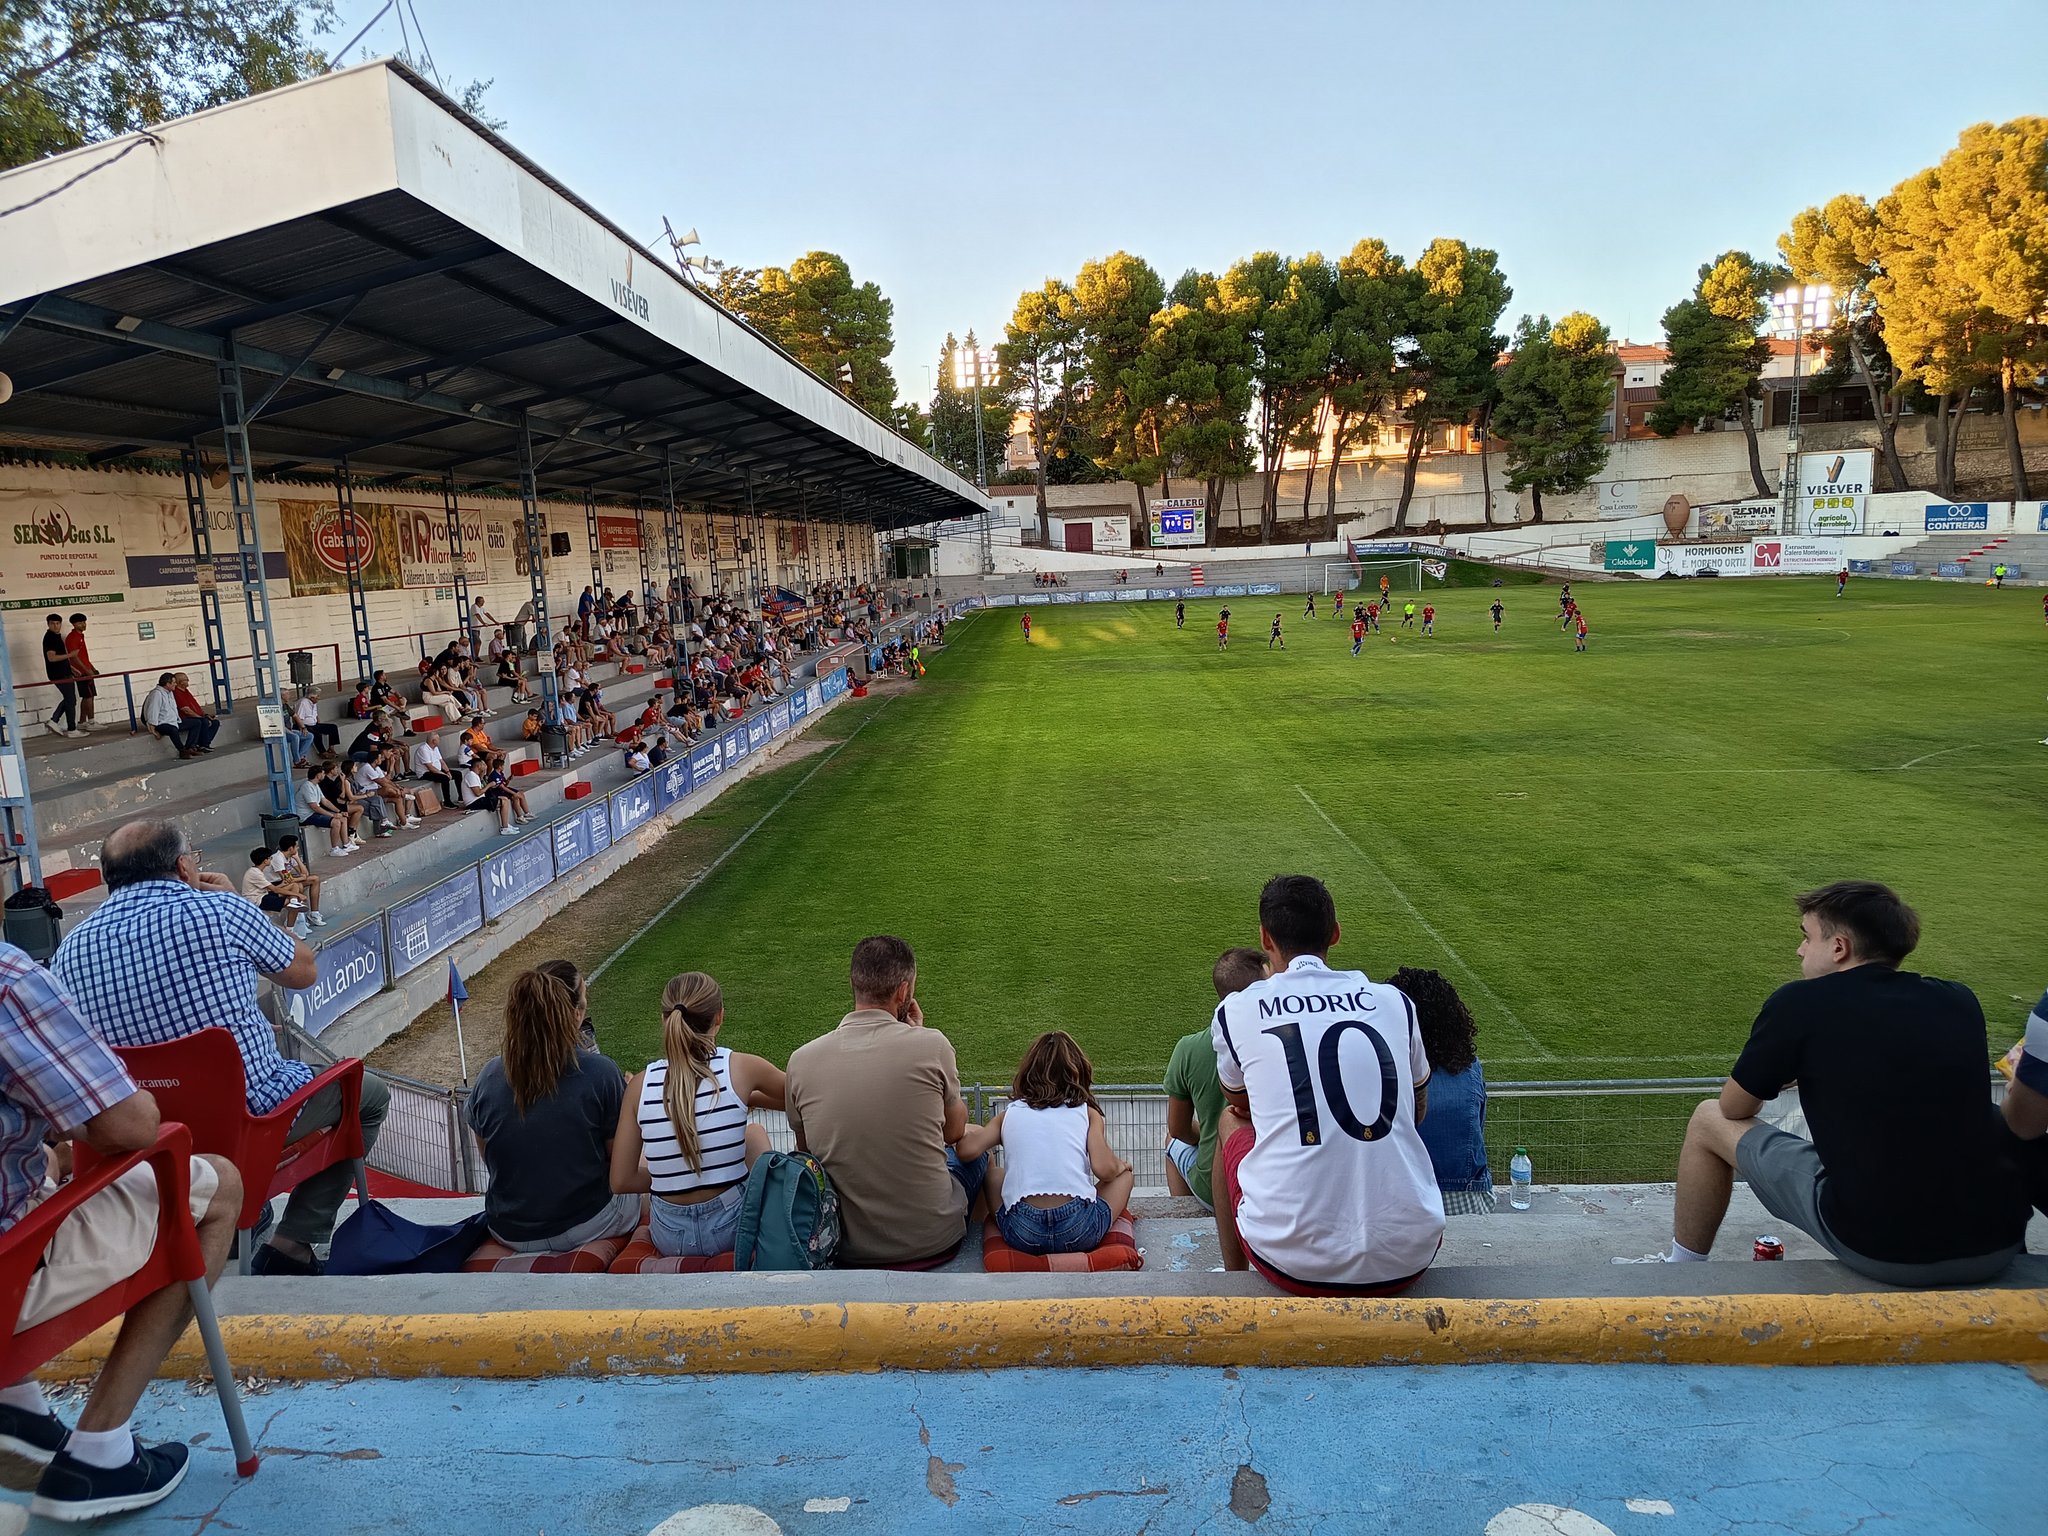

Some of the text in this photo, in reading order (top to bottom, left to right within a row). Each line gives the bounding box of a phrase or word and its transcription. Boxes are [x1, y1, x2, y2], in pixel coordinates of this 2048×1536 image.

[611, 278, 649, 322] VISEVER
[1807, 484, 1863, 495] VISEVER
[1167, 499, 1204, 507] CALERO
[1731, 507, 1776, 515] RESMAN
[1818, 514, 1847, 522] agrícola
[487, 522, 504, 533] BALÓN
[1927, 521, 1985, 530] CONTRERAS
[94, 525, 115, 543] S.L.
[488, 534, 505, 548] ORO
[1685, 546, 1745, 557] HORMIGONES
[1611, 558, 1648, 567] Globalcaja
[1691, 559, 1722, 569] MORENO
[1725, 558, 1746, 567] ORTIZ
[26, 571, 78, 579] TRANSFORMACIÓN
[87, 569, 115, 577] VEHÍCULOS
[75, 581, 90, 590] GLP
[67, 595, 110, 605] VILLARROBLEDO
[1259, 987, 1376, 1020] MODRIĆ
[136, 1078, 180, 1089] zcampo
[1261, 1020, 1399, 1147] 10
